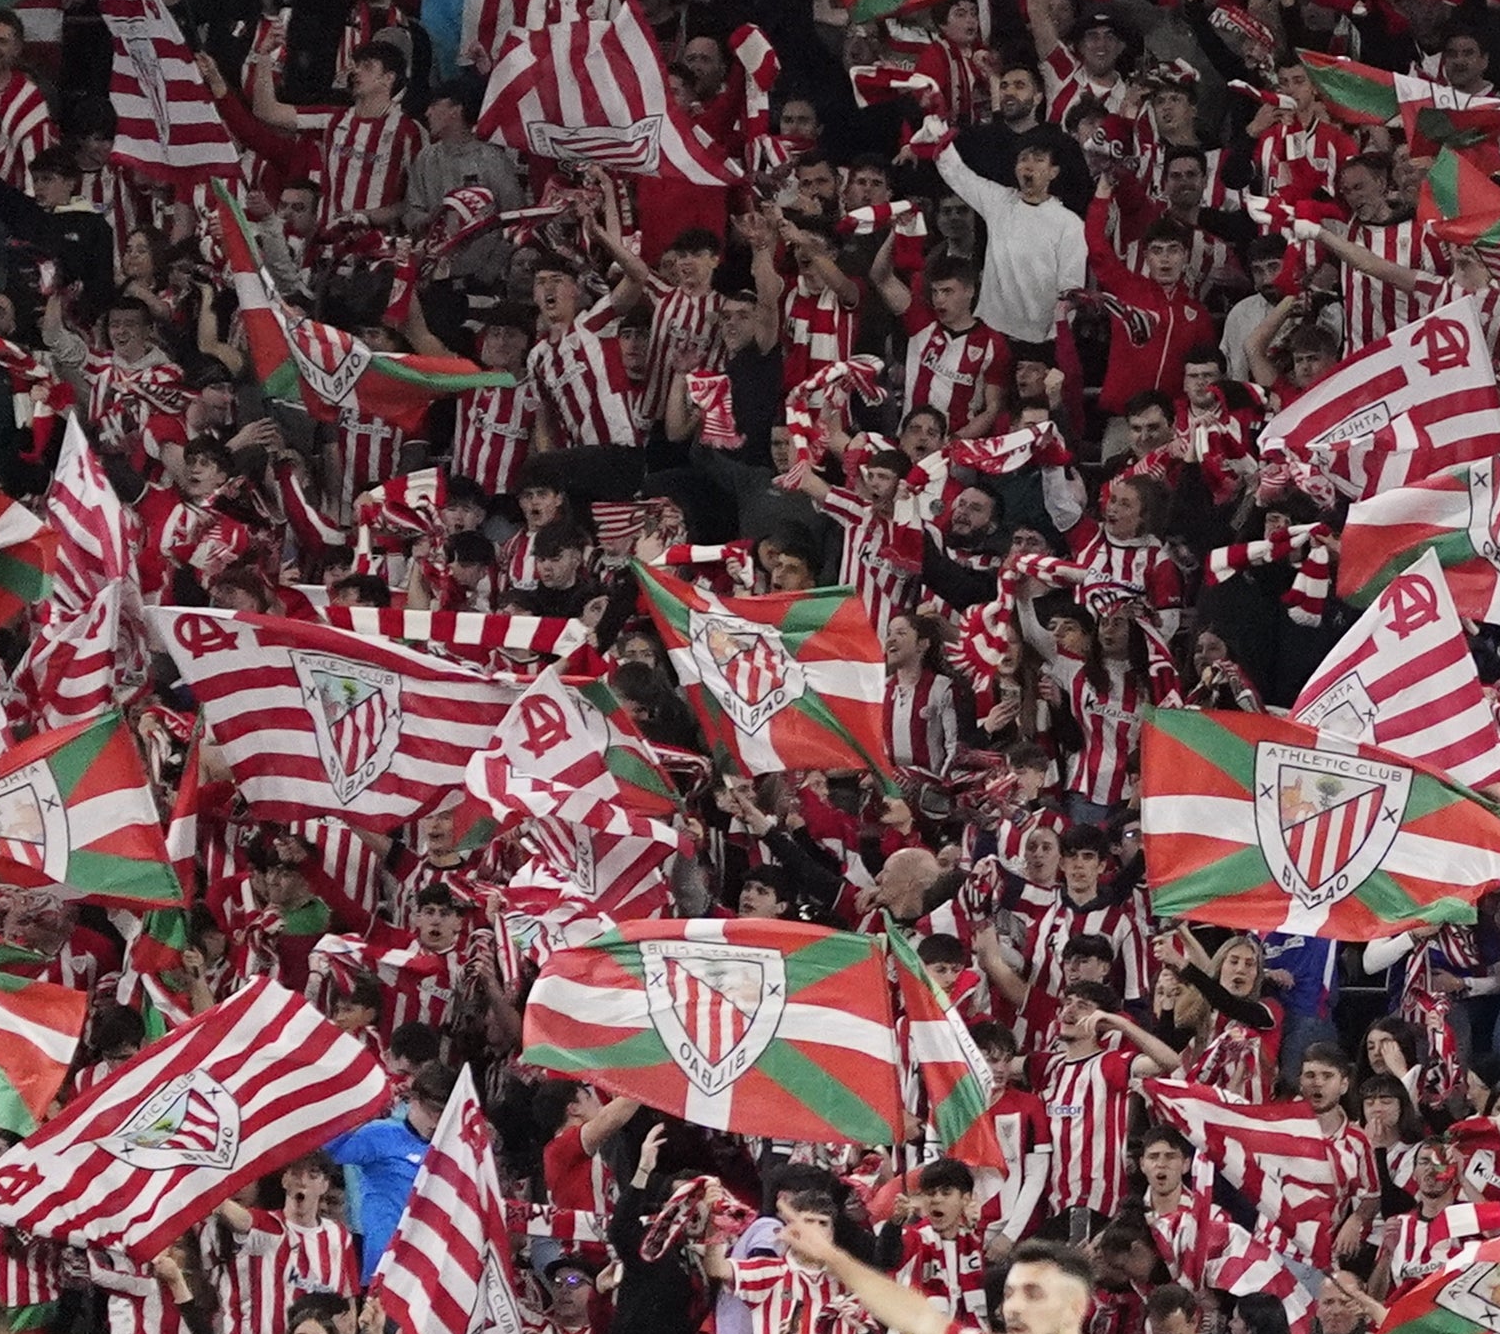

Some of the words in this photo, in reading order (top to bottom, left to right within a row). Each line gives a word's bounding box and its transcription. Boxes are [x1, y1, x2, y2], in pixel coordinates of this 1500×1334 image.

[722, 688, 786, 728] BILBAO
[1266, 746, 1351, 773] ATHLETIC
[1356, 762, 1404, 784] CLUB
[1399, 1260, 1447, 1276] Kutxaban
